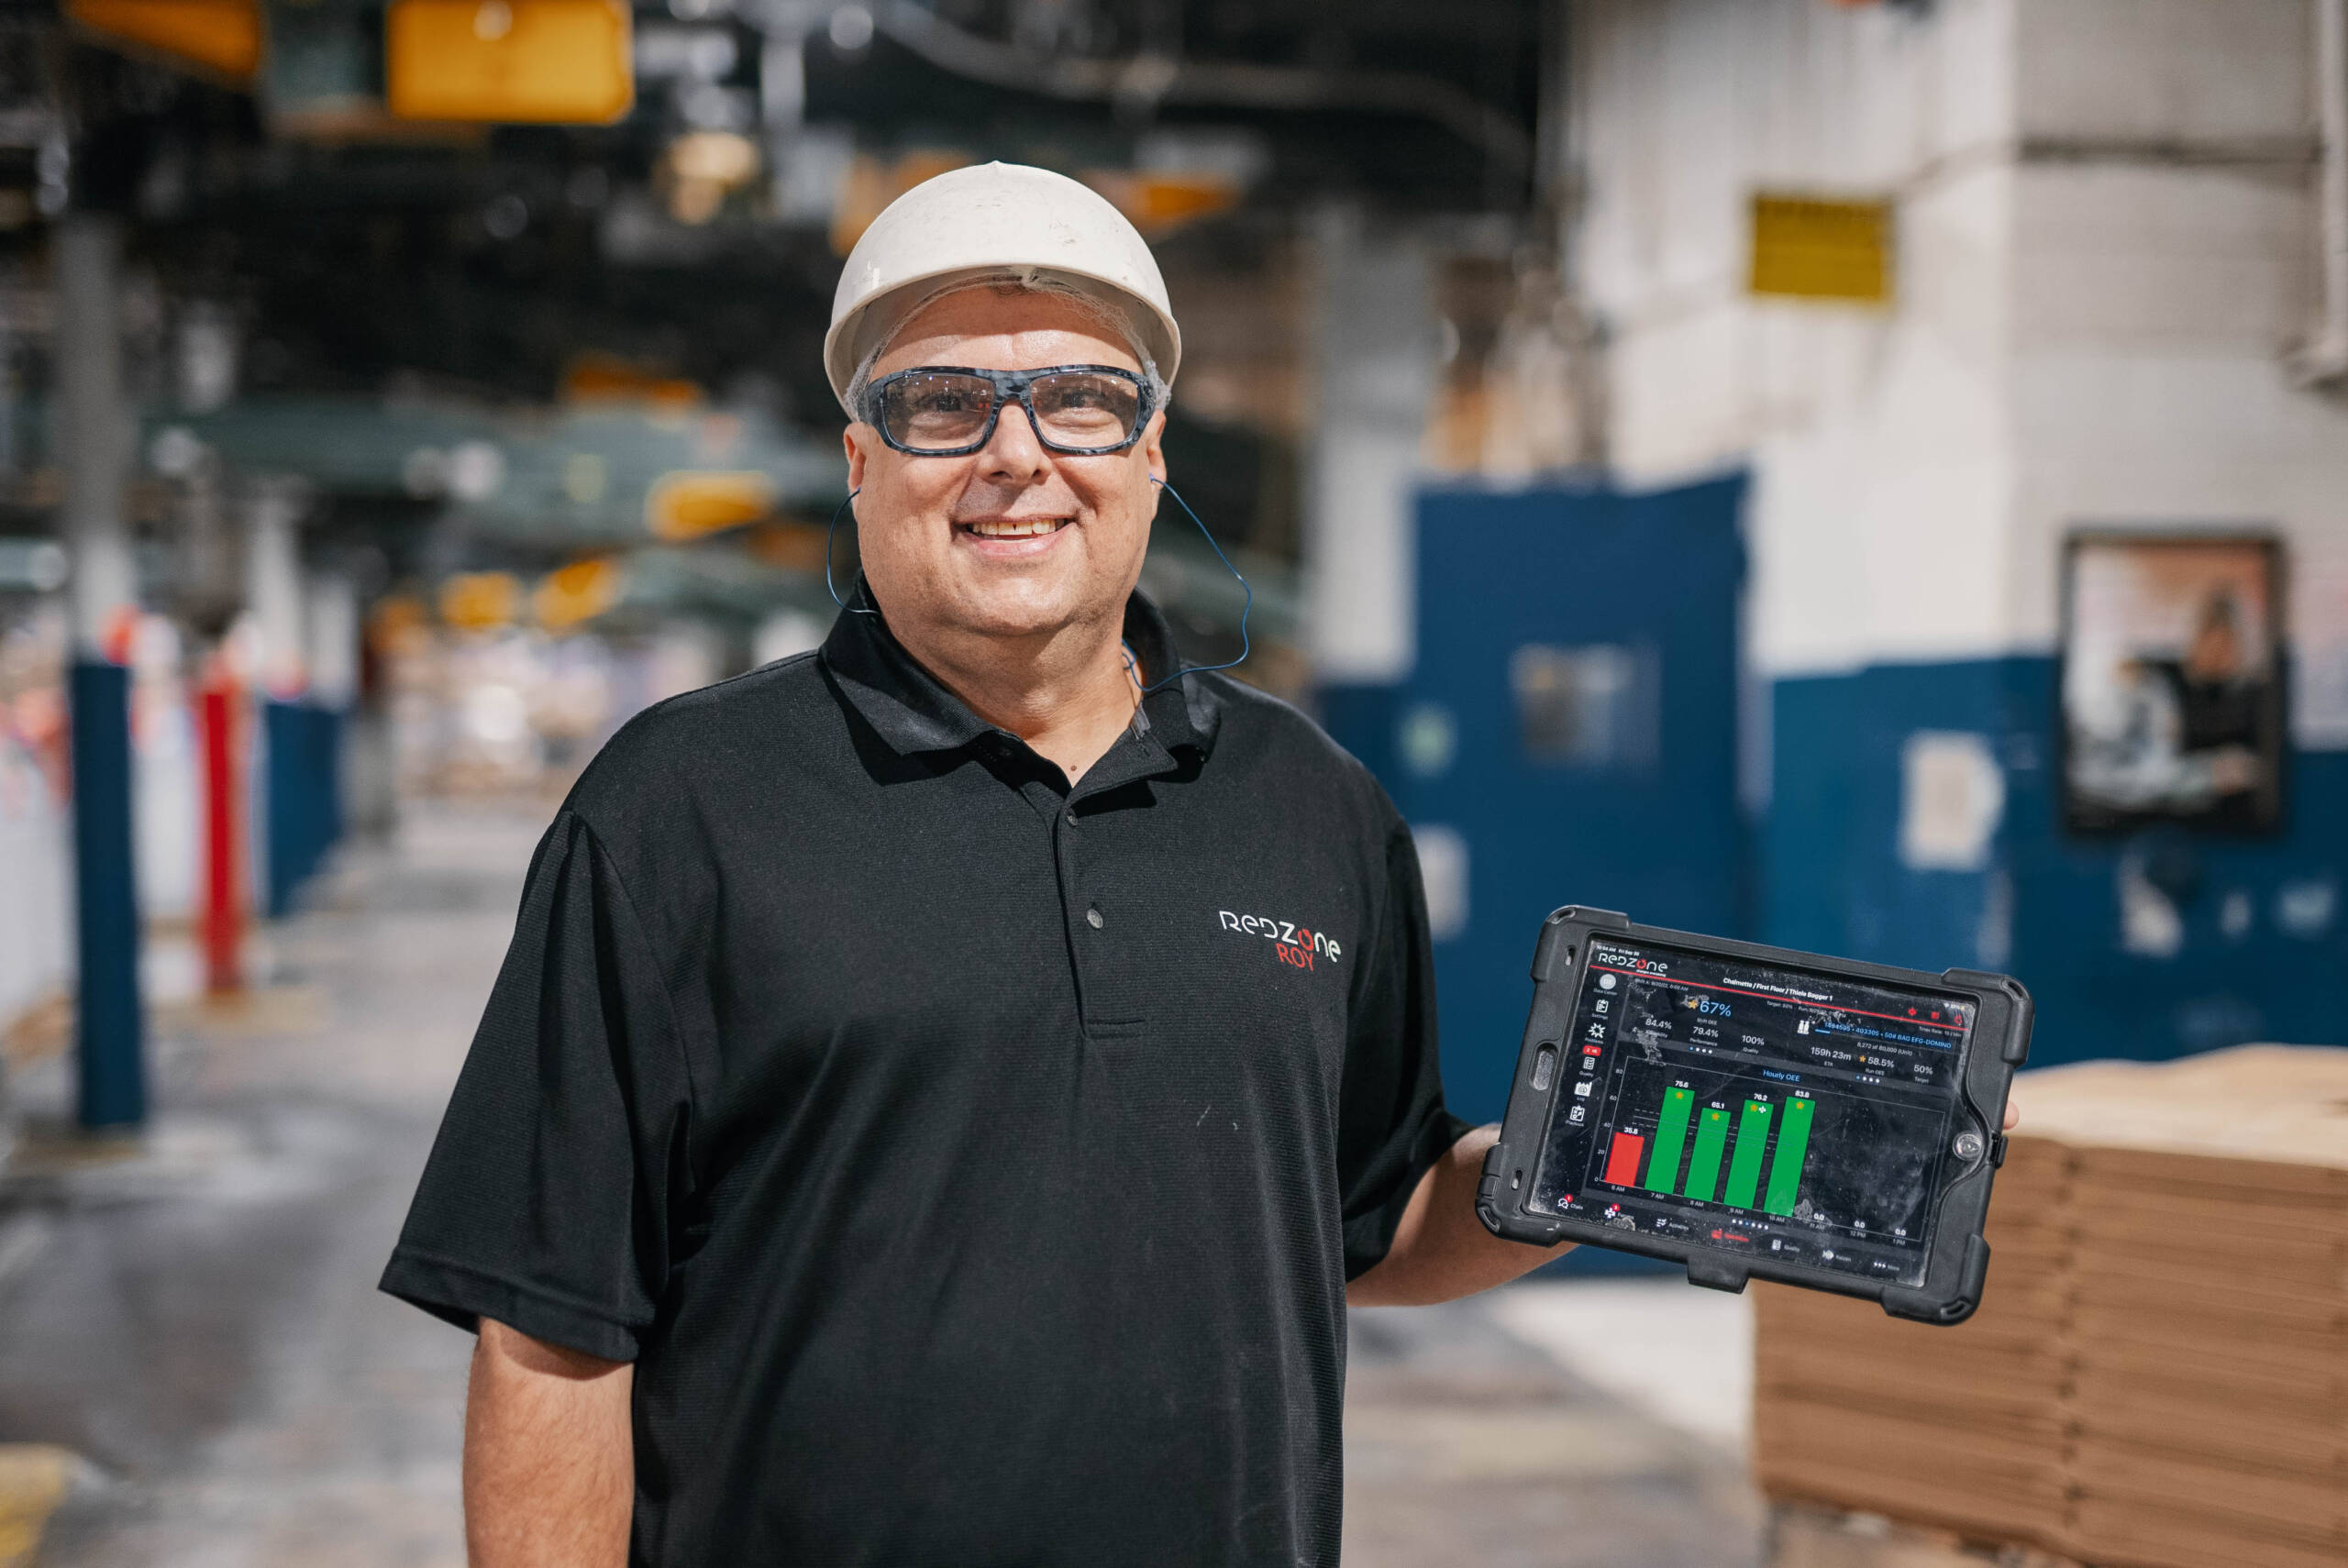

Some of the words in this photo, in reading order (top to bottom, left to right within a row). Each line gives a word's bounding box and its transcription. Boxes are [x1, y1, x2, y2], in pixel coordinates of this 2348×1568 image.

[1276, 943, 1313, 972] ROY
[1722, 977, 1753, 988] Chalmette
[1770, 985, 1786, 993] Floor
[1789, 988, 1807, 997] Thiele
[1807, 990, 1829, 1001] Bagger
[1700, 1000, 1732, 1017] 67%
[1645, 1018, 1672, 1030] 84.4%
[1692, 1027, 1719, 1038] 79.4%
[1742, 1034, 1765, 1045] 100%
[1811, 1046, 1832, 1057] 159h
[1833, 1050, 1852, 1061] 23m
[1867, 1056, 1895, 1068] 58.5%
[1763, 1069, 1785, 1080] Hourly
[1786, 1073, 1801, 1082] OEE
[1913, 1064, 1933, 1076] 50%
[1754, 1093, 1767, 1101] 76.2
[1623, 1127, 1638, 1135] 35.8
[1854, 1220, 1866, 1229] 0.0
[1895, 1228, 1907, 1236] 0.0
